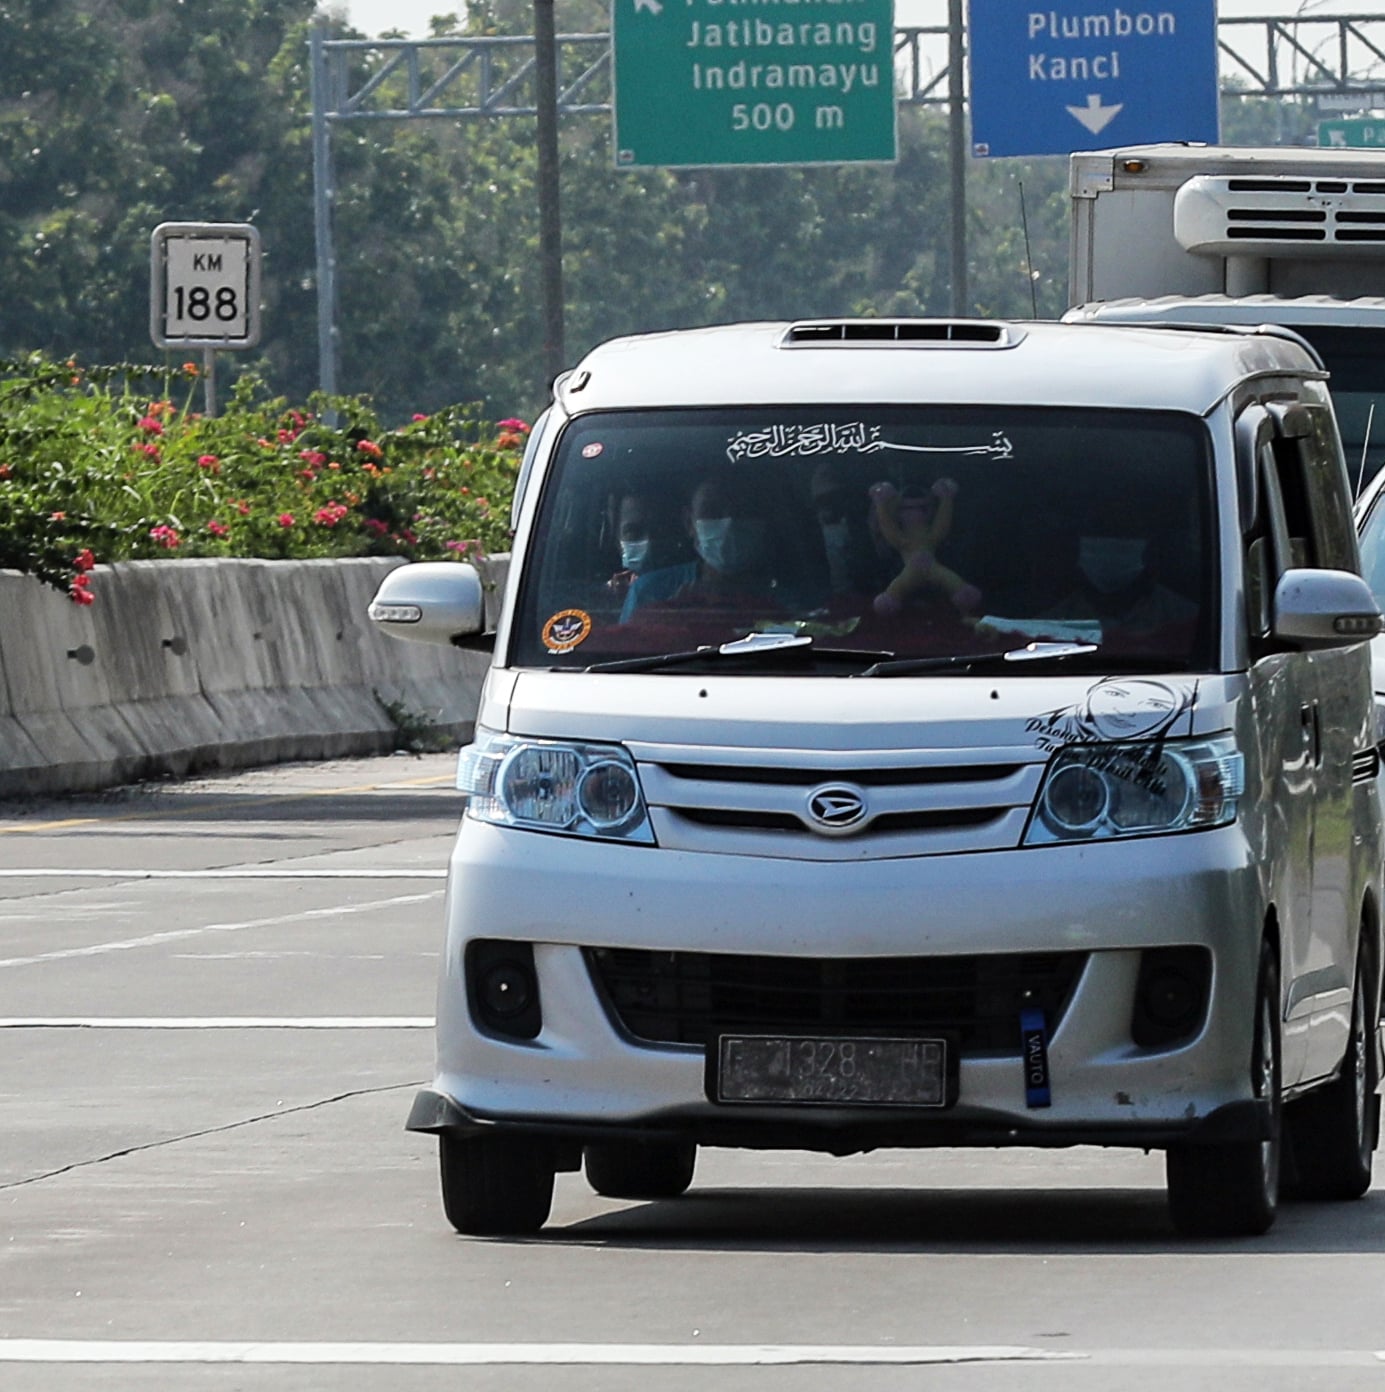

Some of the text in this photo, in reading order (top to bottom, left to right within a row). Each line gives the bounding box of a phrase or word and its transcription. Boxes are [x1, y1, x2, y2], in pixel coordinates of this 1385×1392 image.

[686, 19, 877, 51] Jatibarang
[1028, 9, 1176, 39] Plumbon
[692, 61, 880, 93] Indramayu
[1029, 51, 1121, 81] Kanci
[732, 103, 844, 130] 500 m
[193, 254, 222, 272] KM
[174, 286, 238, 321] 188
[1028, 1034, 1044, 1084] VAUTO
